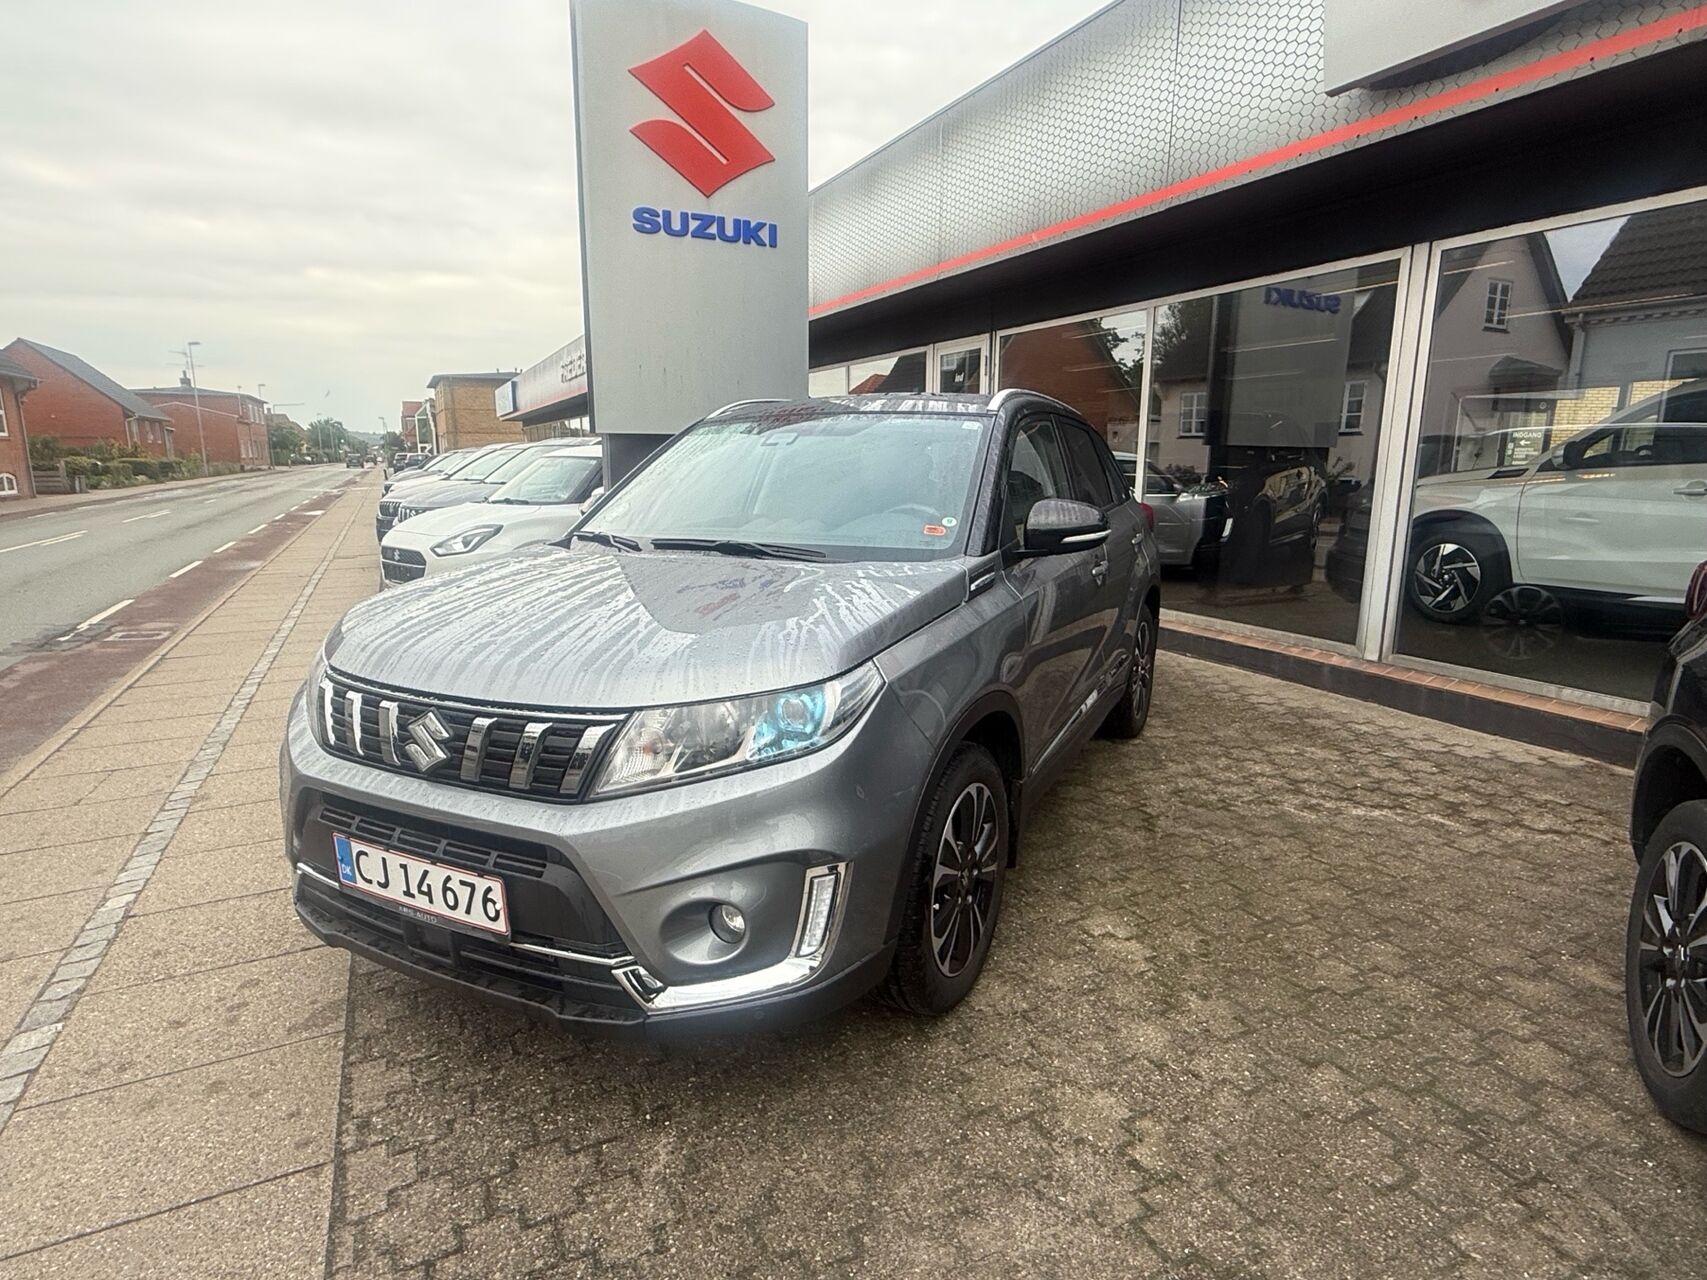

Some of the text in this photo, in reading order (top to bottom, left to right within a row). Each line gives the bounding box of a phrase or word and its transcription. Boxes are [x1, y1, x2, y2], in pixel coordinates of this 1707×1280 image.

[632, 206, 778, 249] SUZUKI
[341, 863, 353, 876] DK
[355, 850, 390, 889] CJ
